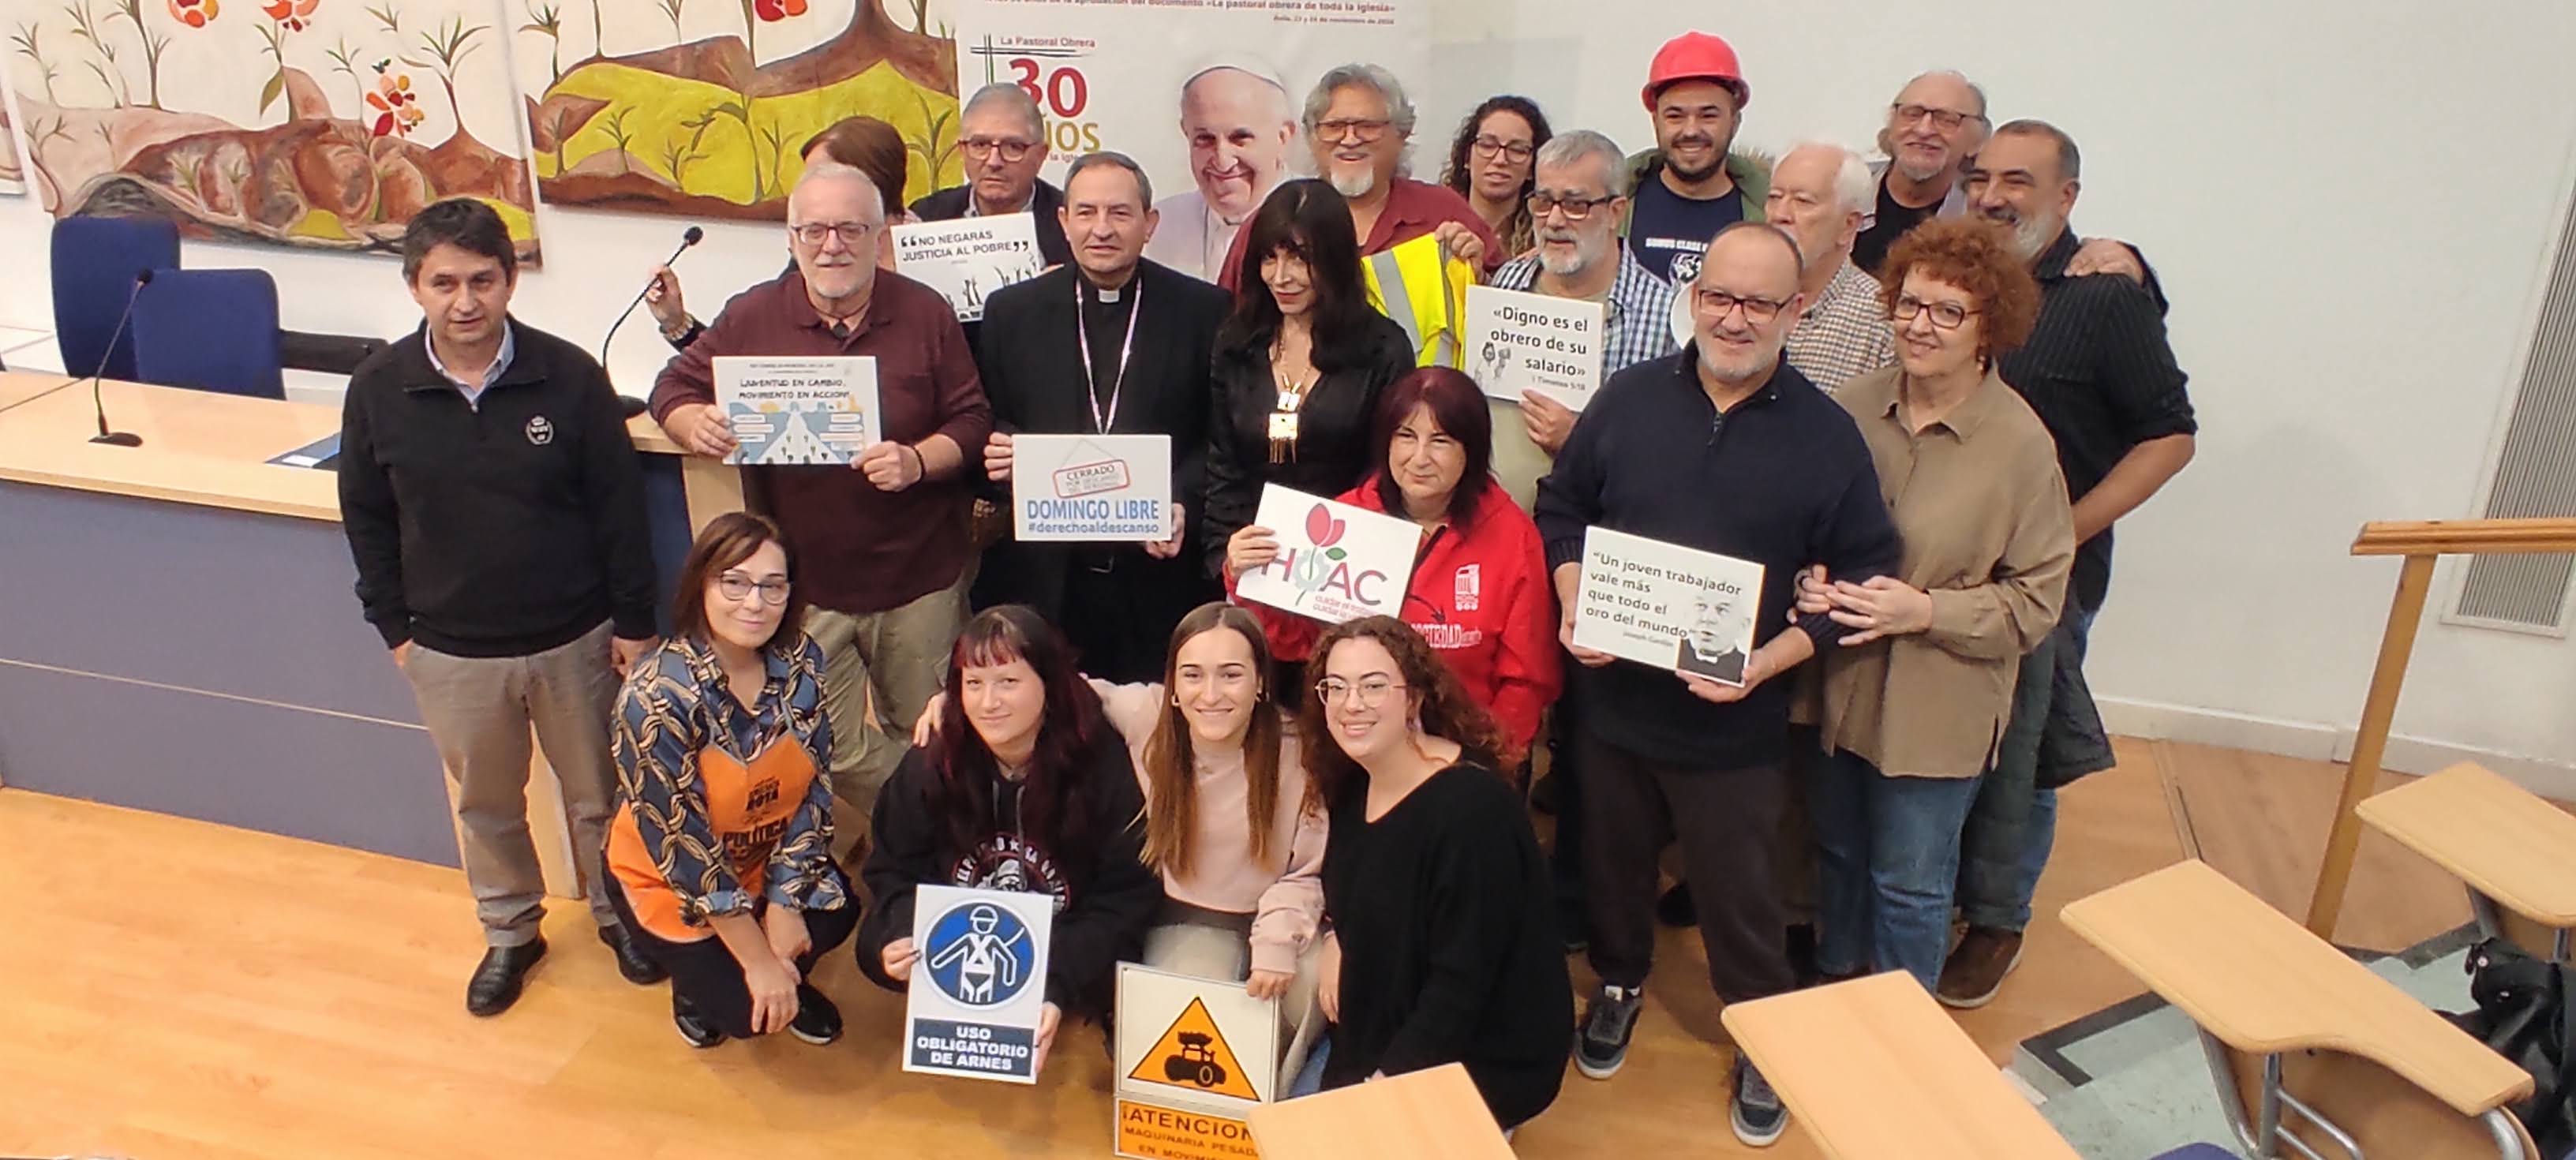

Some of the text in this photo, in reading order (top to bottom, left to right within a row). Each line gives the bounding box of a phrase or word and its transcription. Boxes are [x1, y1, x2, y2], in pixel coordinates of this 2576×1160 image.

[1226, 0, 1266, 9] pastoral
[1268, 1, 1301, 9] obrera
[1319, 2, 1342, 10] toda
[1345, 2, 1354, 11] la
[1000, 36, 1095, 47] La Pastoral Obrera
[1009, 58, 1088, 118] 30
[903, 249, 953, 262] JUSTICIA
[957, 247, 971, 256] AL
[1553, 316, 1569, 329] es
[1574, 319, 1588, 331] el
[1491, 328, 1587, 354] obrero de su
[1525, 357, 1586, 376] salario»
[1066, 464, 1115, 481] CERRADO
[1027, 500, 1159, 520] DOMINGO LIBRE
[1028, 521, 1159, 533] #derechoaldescanso
[1590, 571, 1651, 593] vale más
[1623, 559, 1662, 578] joven
[1665, 570, 1742, 595] trabajador
[1587, 589, 1668, 615] que todo el
[1586, 606, 1609, 619] oro
[1613, 611, 1634, 625] del
[956, 1026, 992, 1040] USO
[916, 1036, 1028, 1058] OBLIGATORIO
[930, 1051, 1013, 1071] DE ARNES
[1124, 1127, 1260, 1158] MAQUINARIA PESAD
[1138, 1145, 1156, 1154] EN
